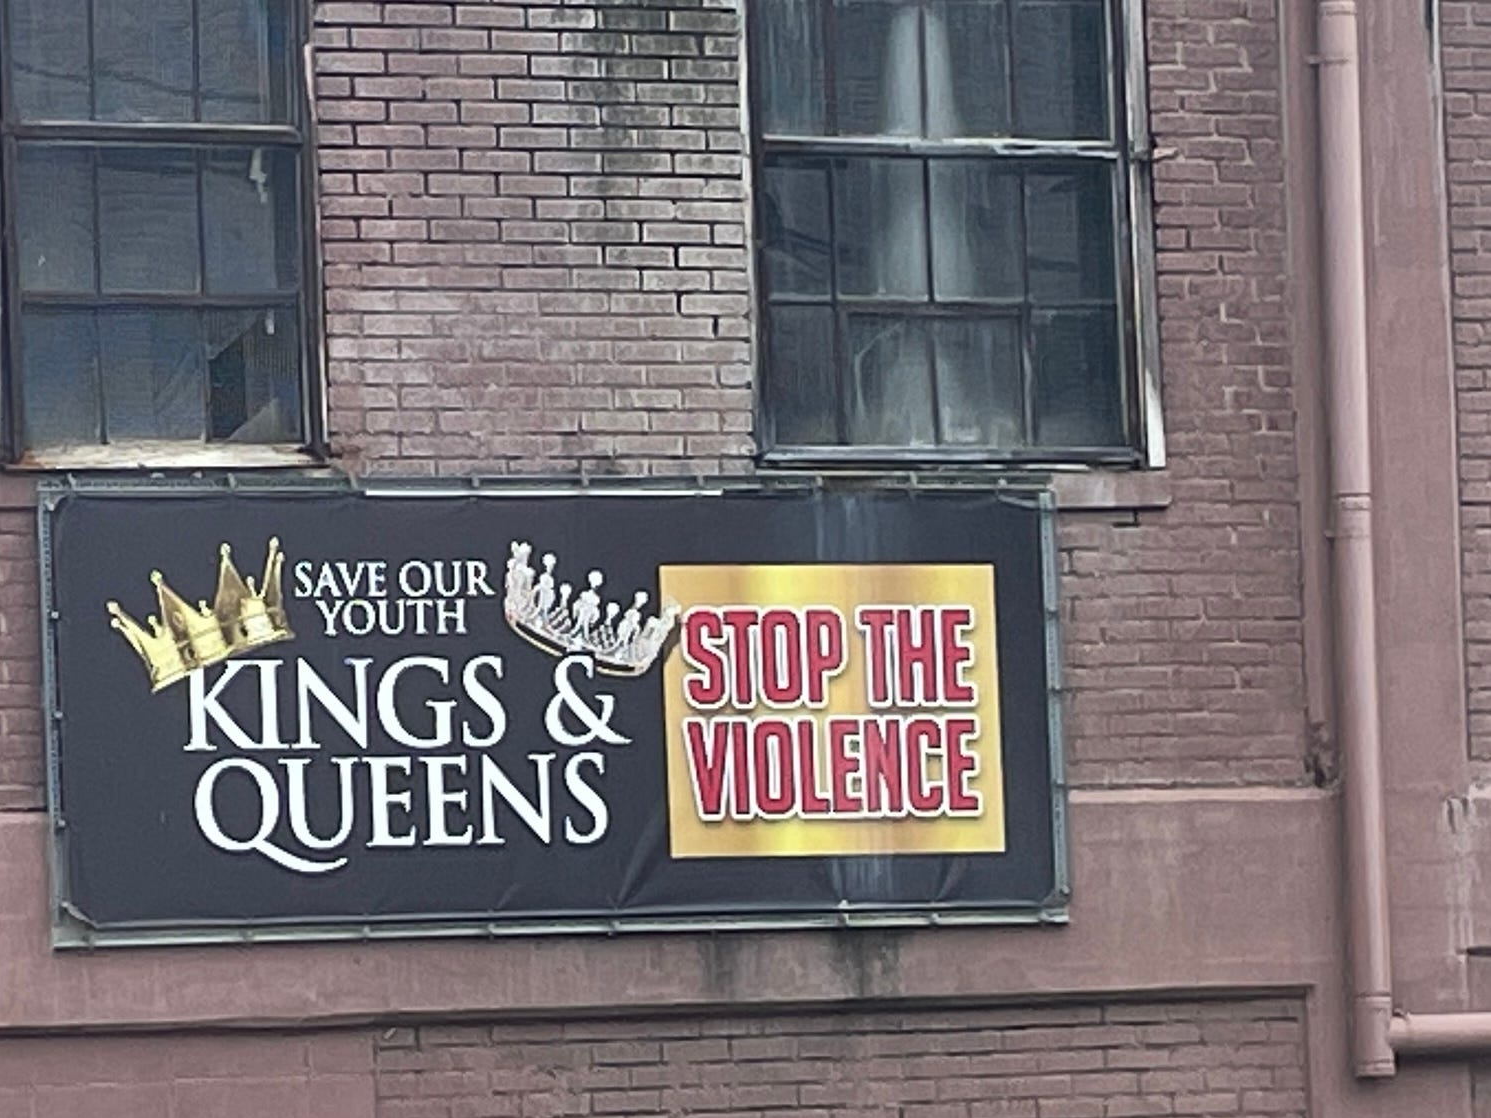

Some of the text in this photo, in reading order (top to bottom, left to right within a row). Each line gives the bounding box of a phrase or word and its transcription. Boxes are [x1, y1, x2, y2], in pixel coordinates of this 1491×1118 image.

[294, 560, 496, 598] SAVE OUR
[314, 598, 468, 637] YOUTH
[183, 653, 633, 752] KINGS &
[682, 607, 973, 706] STOP THE
[194, 752, 609, 873] QUEENS
[686, 717, 979, 818] VIOLENCE
